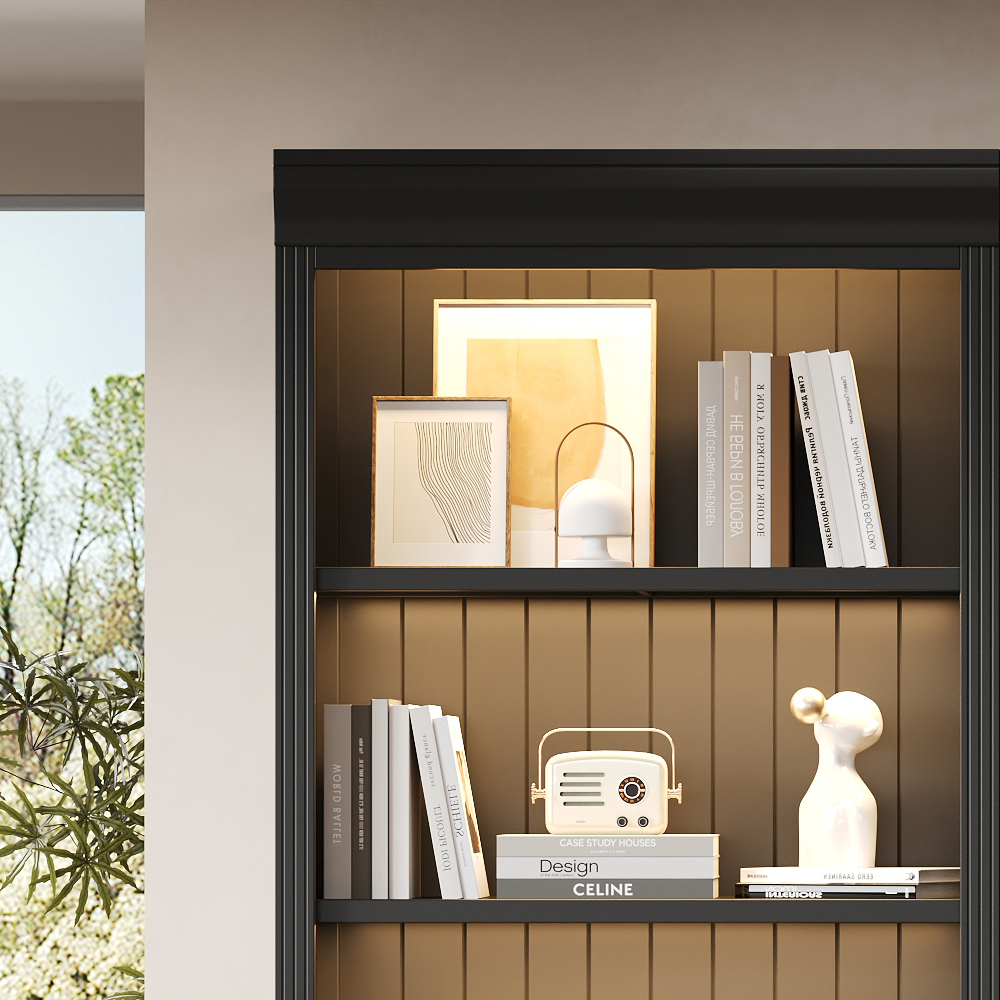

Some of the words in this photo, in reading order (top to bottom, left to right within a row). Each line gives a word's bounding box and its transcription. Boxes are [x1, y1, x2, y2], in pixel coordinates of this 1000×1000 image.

[560, 839, 584, 847] CASE
[586, 839, 616, 847] STUDY
[618, 839, 656, 847] HOUSES
[540, 860, 599, 877] Design
[573, 883, 633, 896] CELINE
